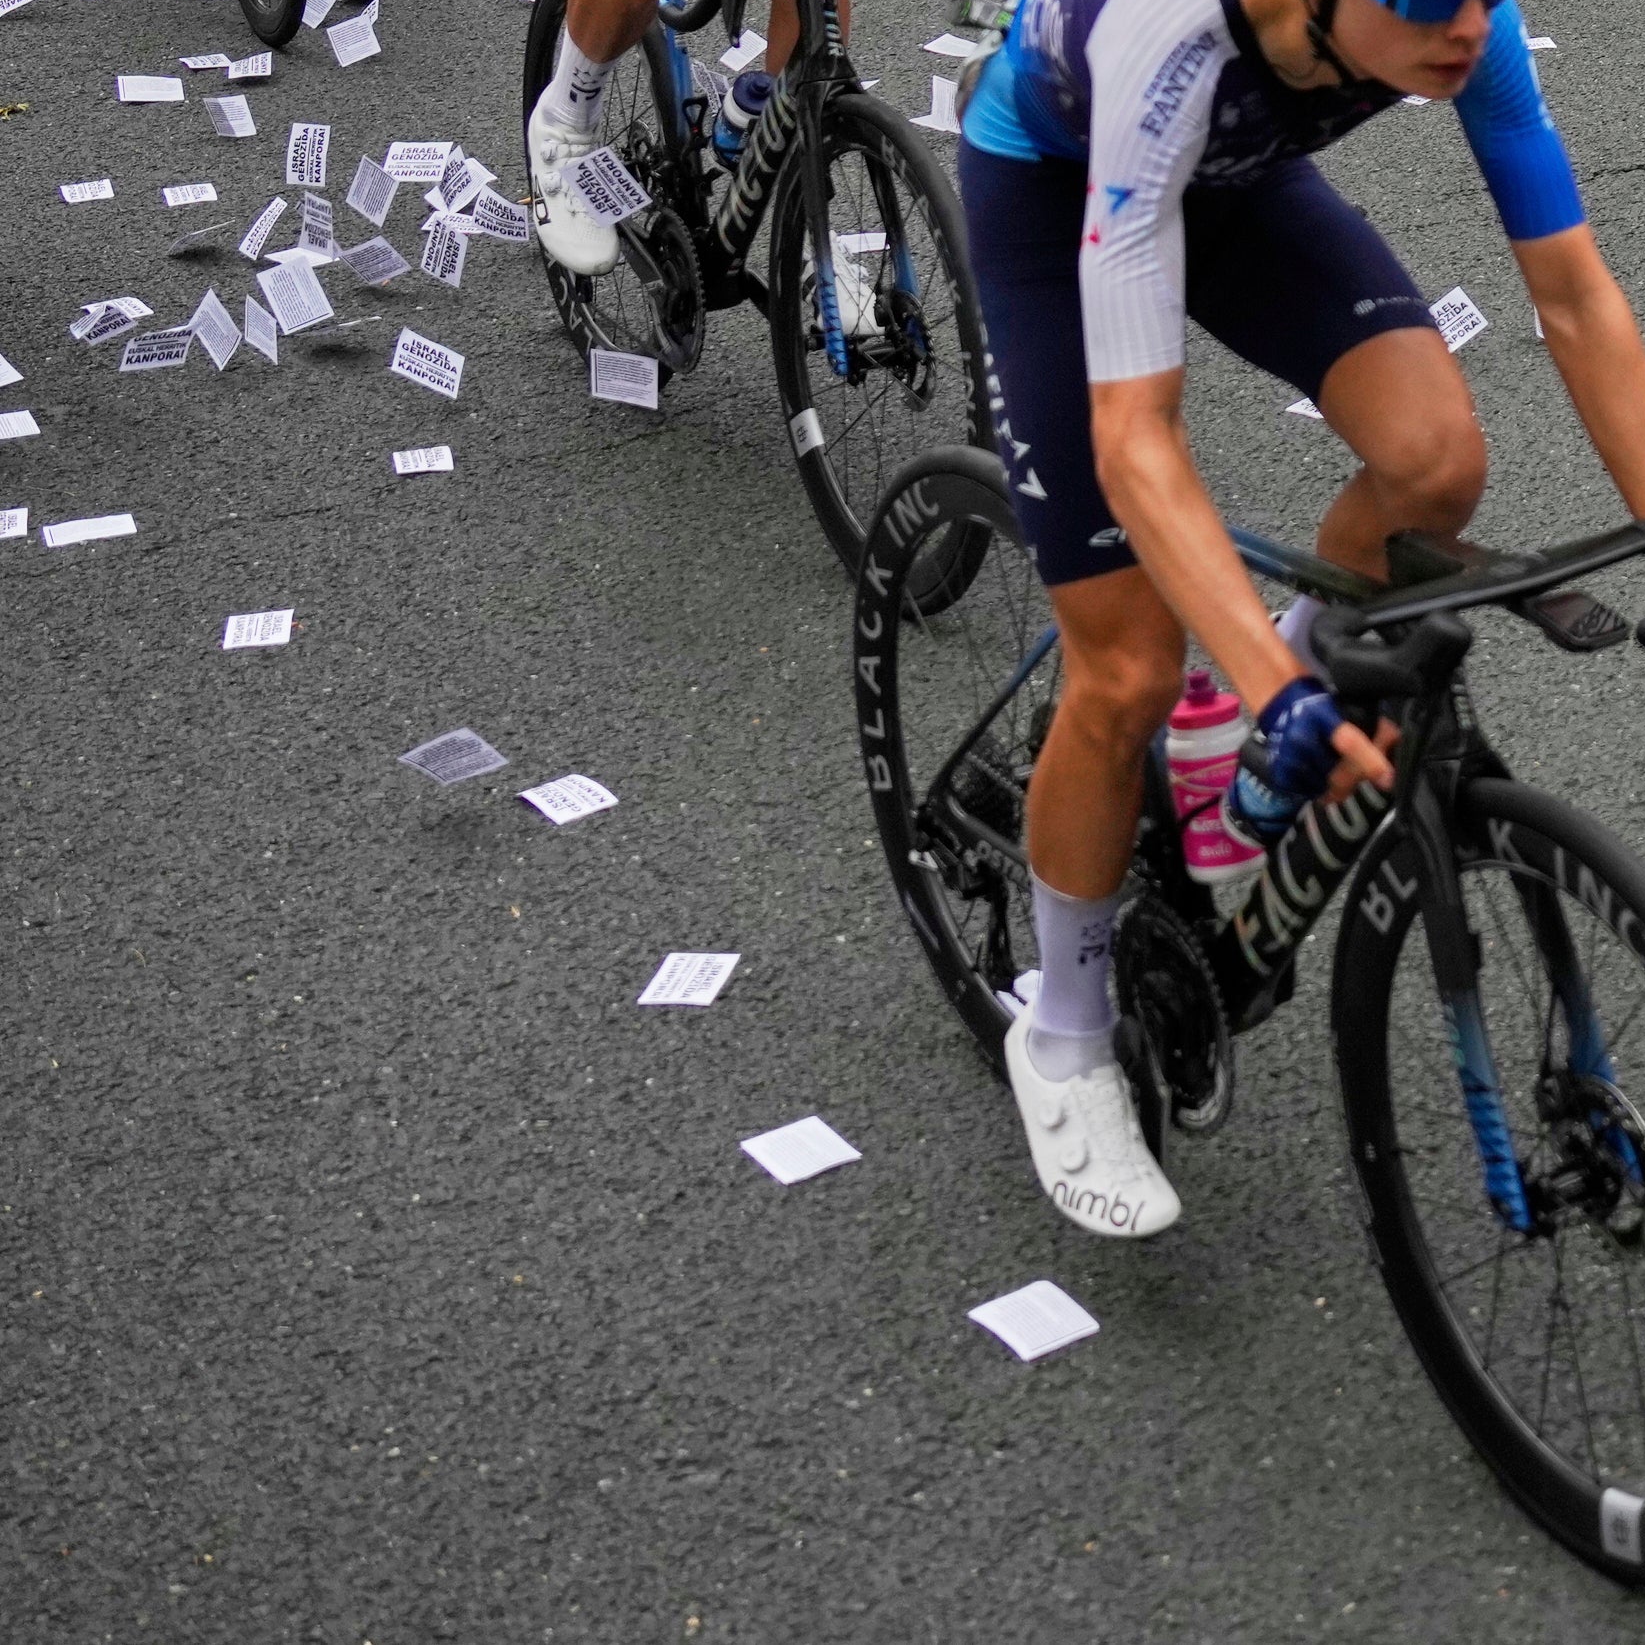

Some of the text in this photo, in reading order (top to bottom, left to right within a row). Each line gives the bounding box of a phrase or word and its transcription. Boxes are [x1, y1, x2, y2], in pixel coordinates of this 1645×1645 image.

[1139, 32, 1216, 138] FANTINI
[292, 135, 301, 173] ISRAEL
[298, 127, 309, 182] GENOZIDA
[315, 128, 326, 183] KANPORA!
[577, 162, 622, 217] GENOZIDA
[577, 175, 608, 215] ISRAEL
[599, 151, 645, 205] KANPORA!
[479, 200, 525, 222] GENOZIDA
[487, 196, 515, 215] ISRAEL
[475, 217, 526, 237] KANPORA!
[424, 220, 441, 271] KANPORA!
[440, 231, 456, 279] GENOZIDA
[448, 242, 460, 274] ISRAEL
[1435, 301, 1456, 319] AEL
[1437, 302, 1468, 328] OZIDA
[85, 316, 131, 341] KANPORA!
[1448, 316, 1481, 345] NPORA!
[126, 350, 185, 365] KANPORA!
[402, 343, 457, 375] GENOZIDA
[412, 339, 450, 363] ISRAEL
[398, 360, 455, 393] KANPORA!
[883, 482, 940, 544] INC
[859, 555, 895, 792] BLACK
[1052, 1182, 1145, 1232] nimbl
